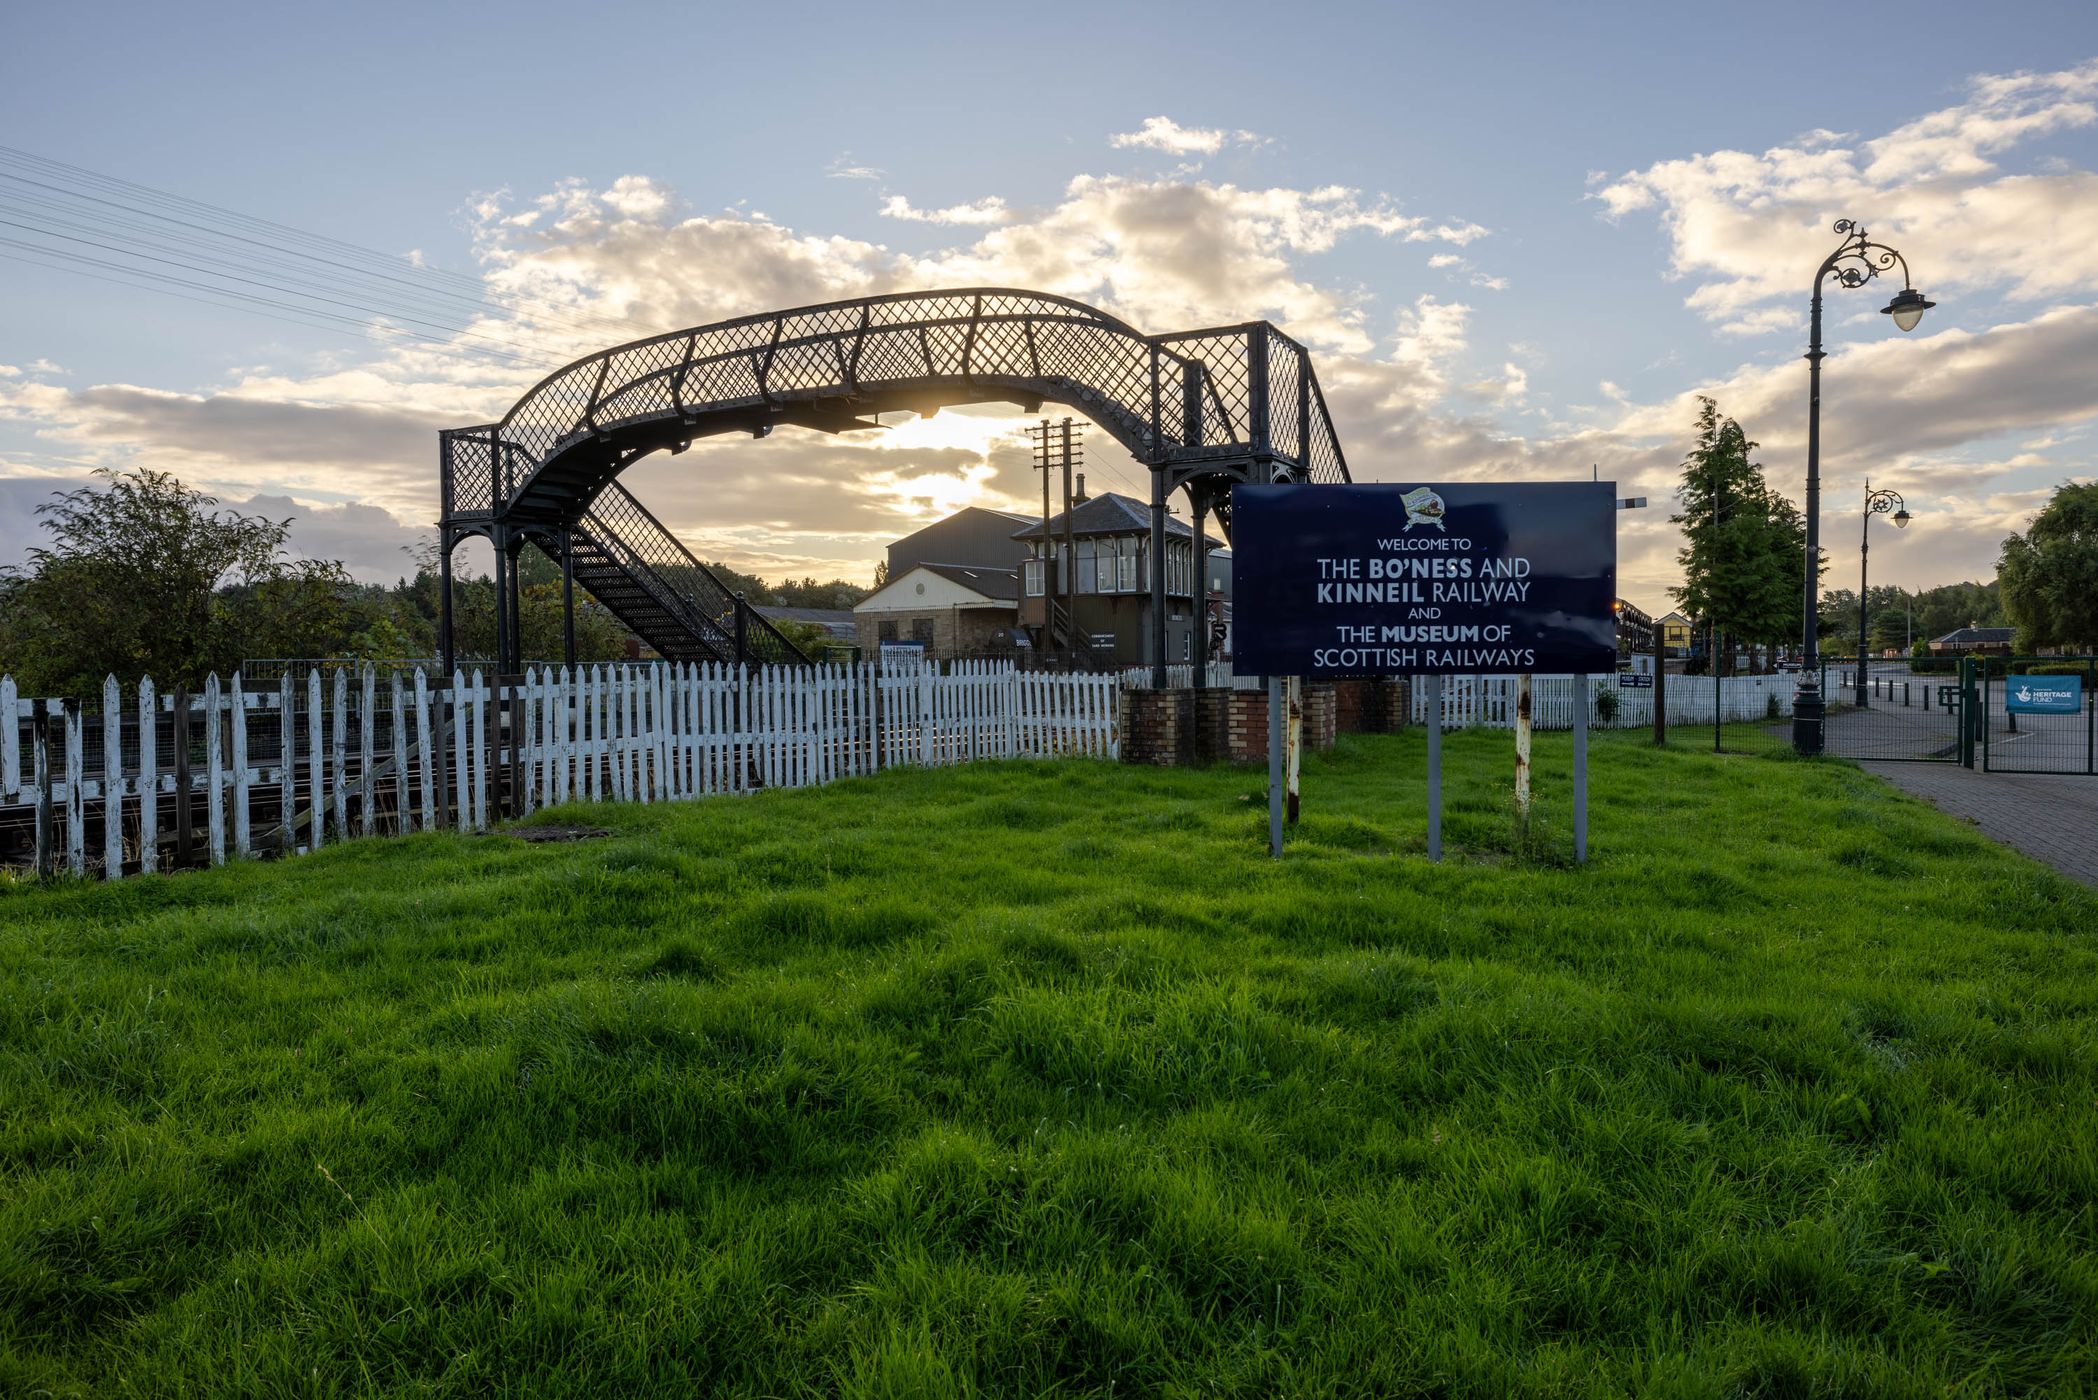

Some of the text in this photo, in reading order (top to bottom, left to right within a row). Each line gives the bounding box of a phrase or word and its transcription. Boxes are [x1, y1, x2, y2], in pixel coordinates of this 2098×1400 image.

[1377, 538, 1472, 551] WELCOME TO
[1317, 557, 1531, 579] THE BO'NESS AND
[1317, 581, 1531, 603] KINNEIL RAILWAY
[1408, 607, 1441, 620] AND
[1336, 625, 1511, 643] THE MUSEUM OF
[1314, 648, 1535, 667] SCOTTISH RAILWAYS
